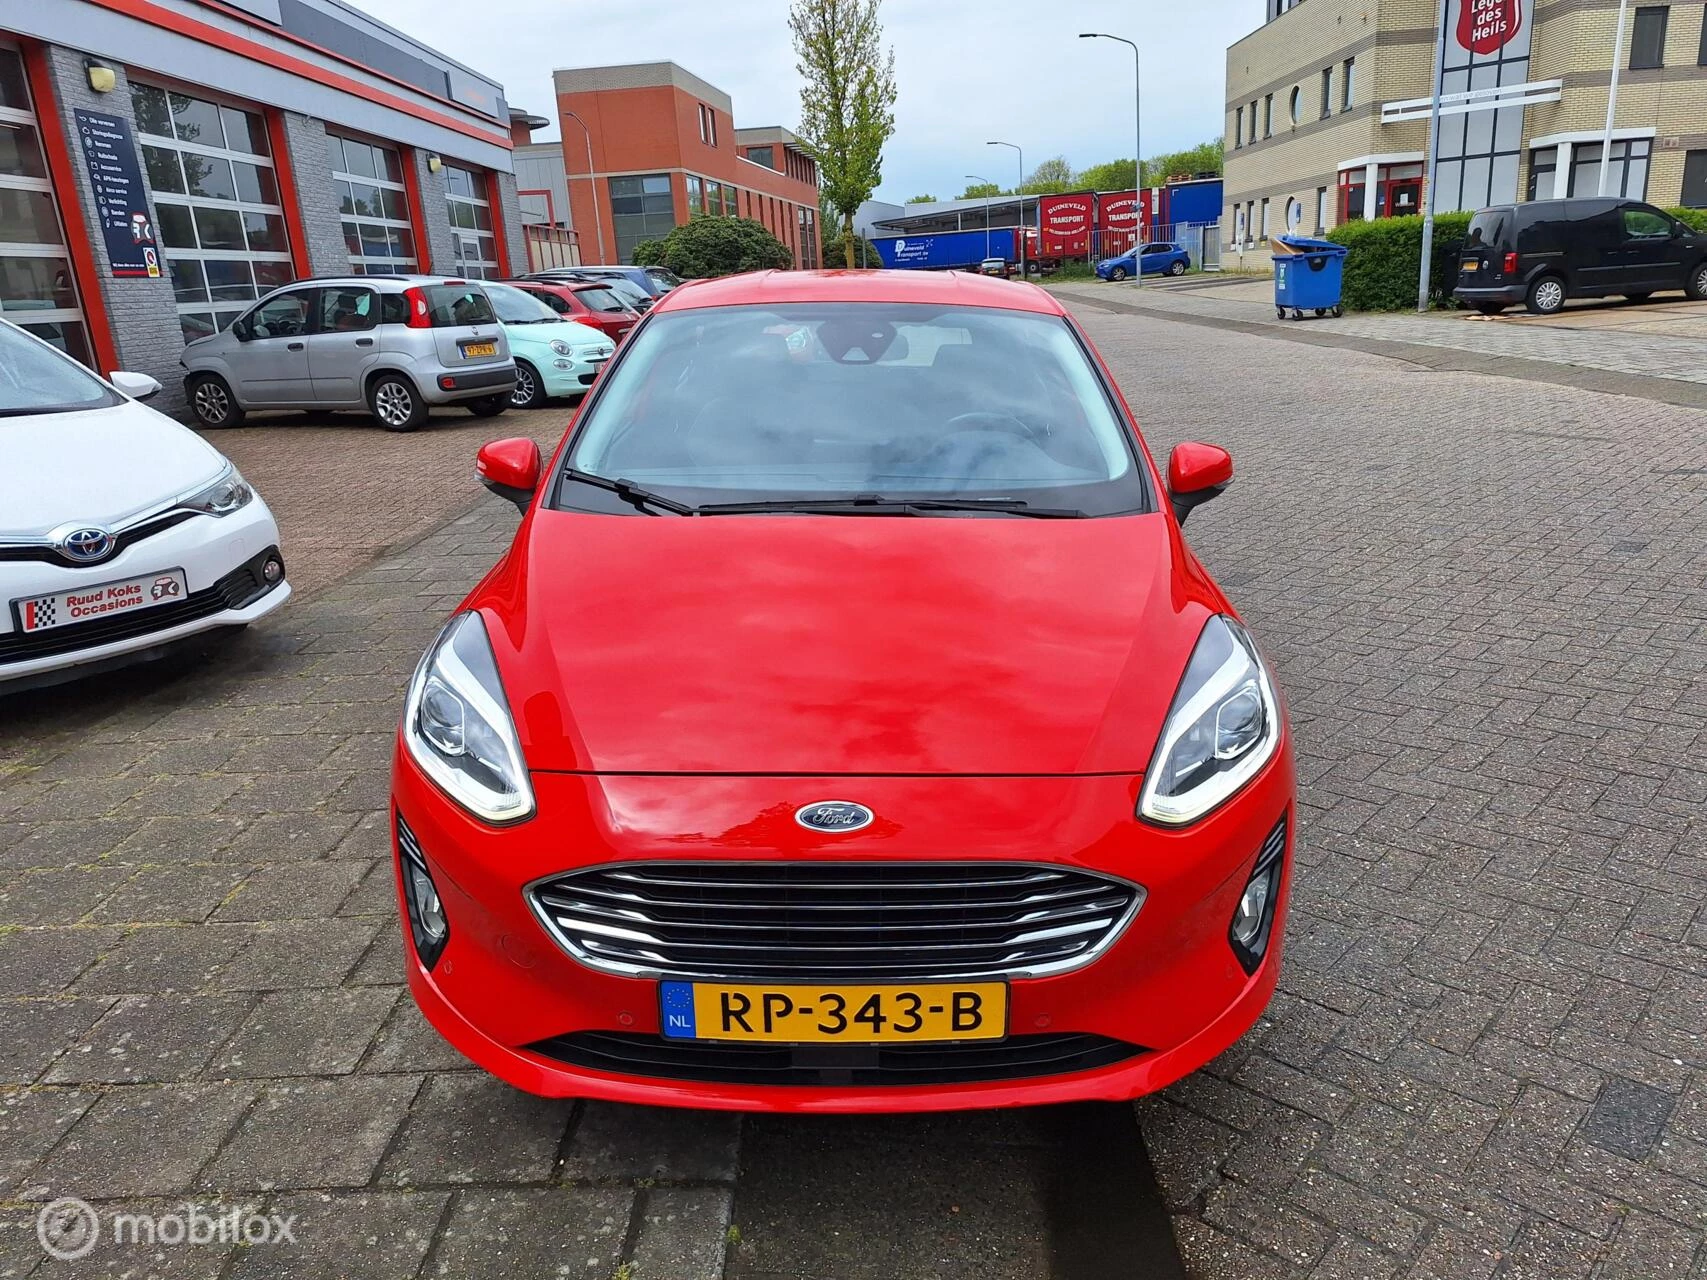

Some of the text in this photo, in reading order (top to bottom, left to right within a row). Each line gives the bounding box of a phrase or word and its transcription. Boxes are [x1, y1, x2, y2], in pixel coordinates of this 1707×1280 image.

[1477, 8, 1502, 26] des
[1472, 20, 1507, 42] Heils
[1048, 203, 1086, 214] DUINEVELD
[1106, 200, 1145, 212] DUINEVED
[1050, 215, 1084, 224] TRANSPORT
[67, 585, 141, 607] Ruud Koks
[71, 596, 143, 617] Occasions
[813, 806, 856, 825] Ford
[669, 991, 983, 1034] NL RP-343-B
